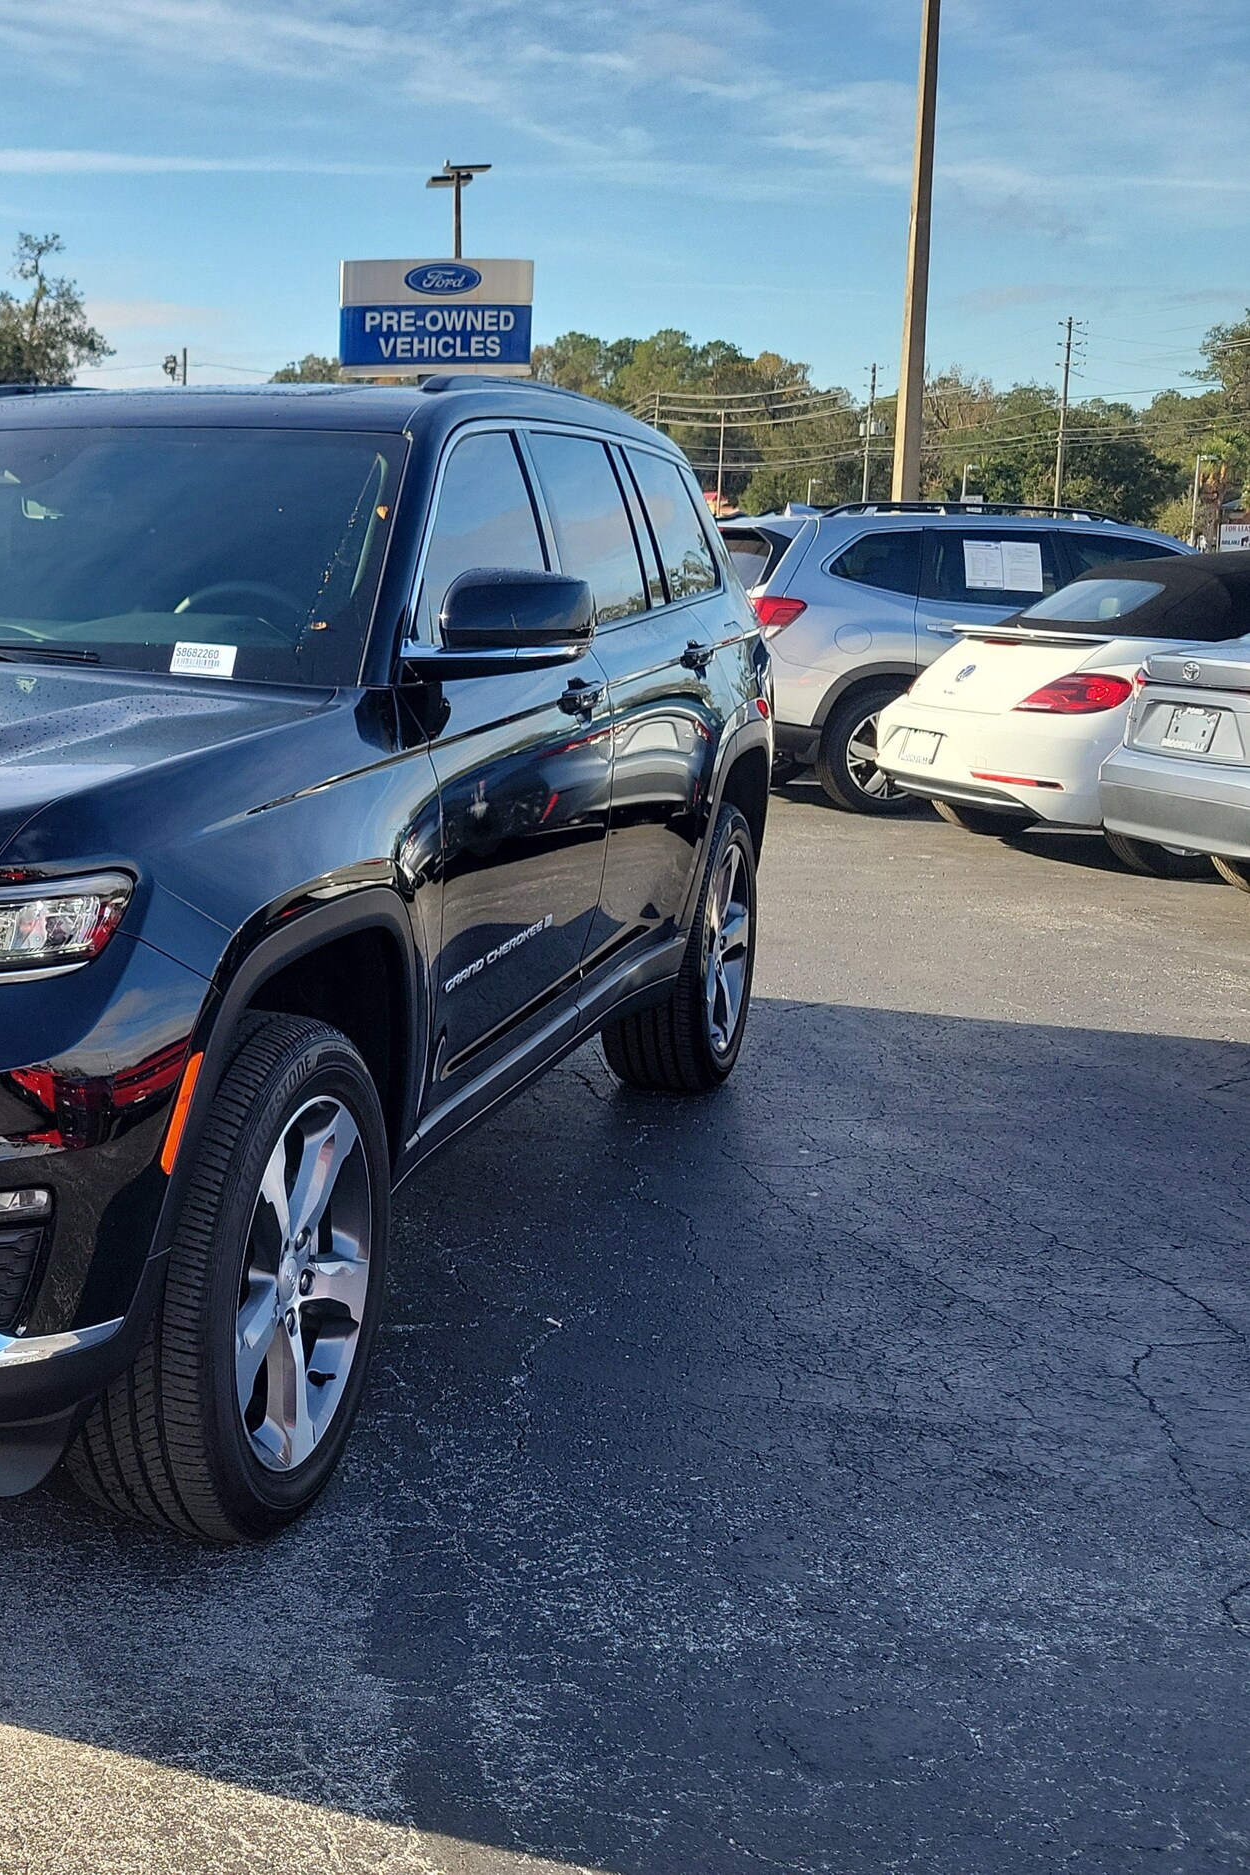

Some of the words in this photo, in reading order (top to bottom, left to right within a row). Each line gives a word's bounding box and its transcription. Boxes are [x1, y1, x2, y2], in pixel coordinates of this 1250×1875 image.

[422, 269, 466, 289] Ford
[364, 310, 516, 333] PRE-OWNED
[378, 336, 501, 358] VEHICLES
[443, 957, 485, 994] GRAND
[484, 919, 544, 965] CHEROKEE
